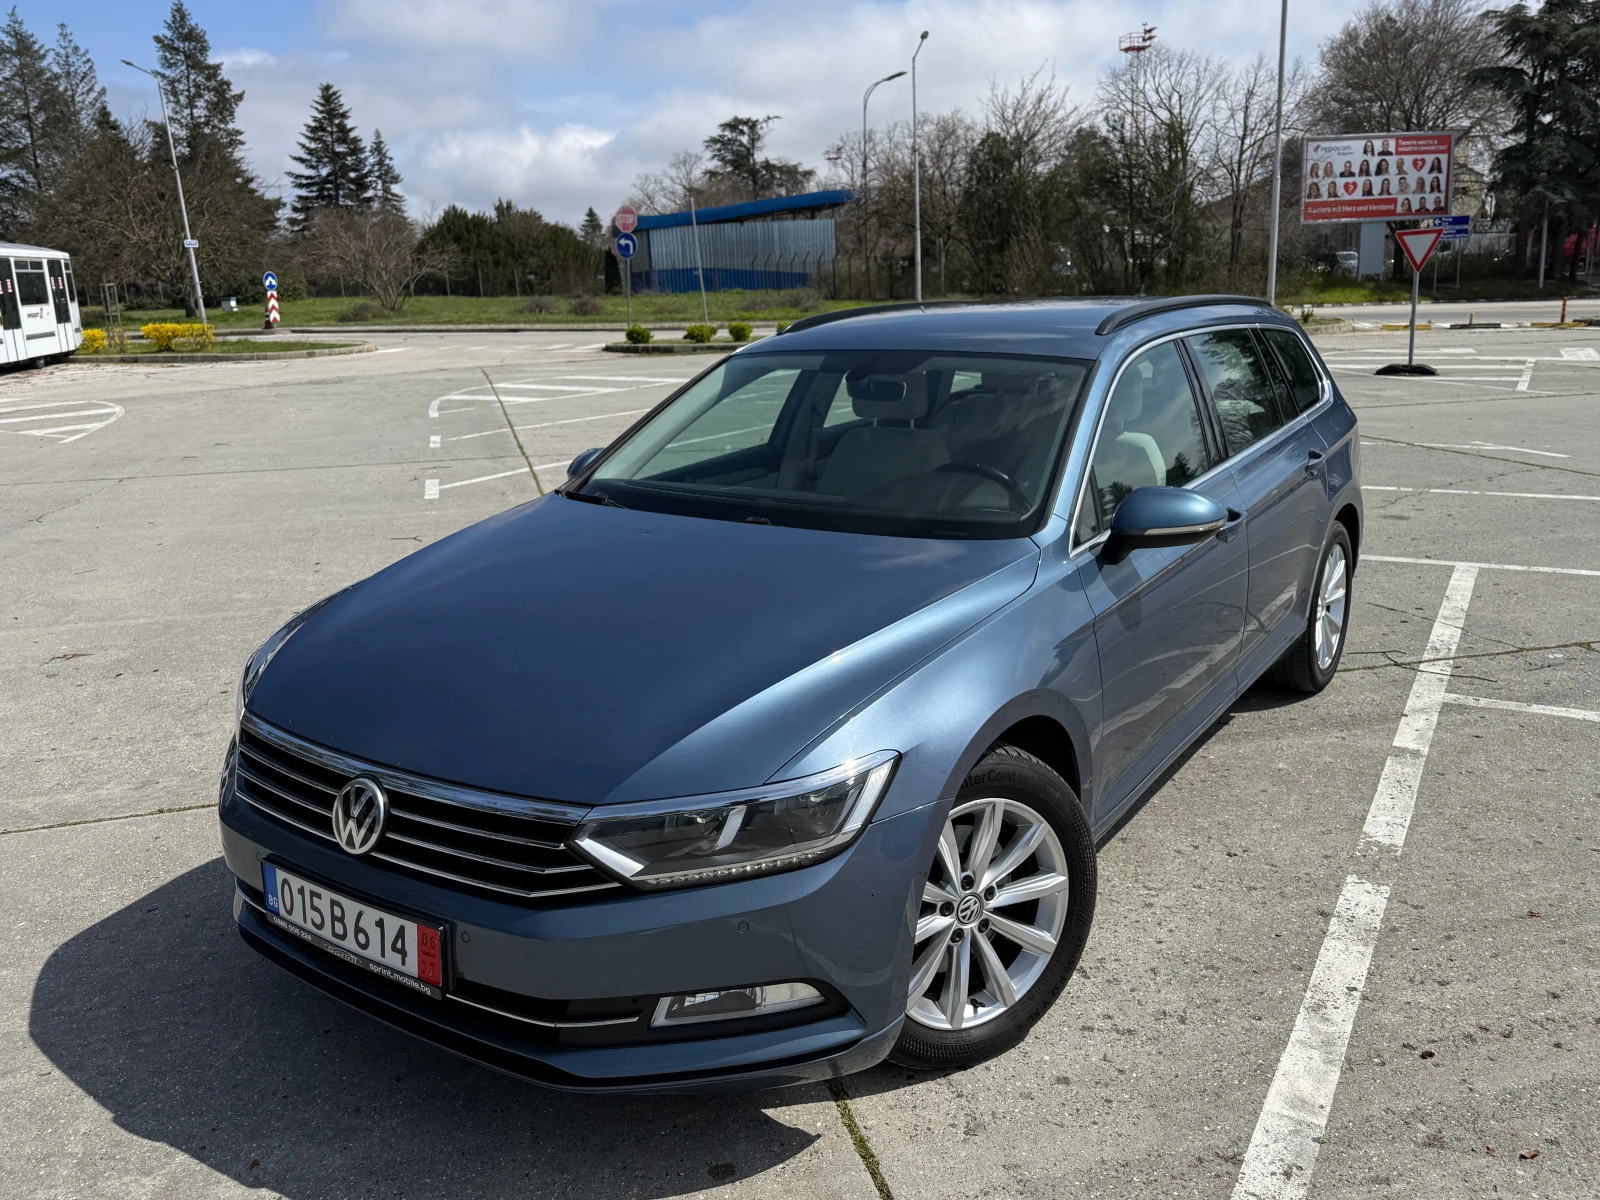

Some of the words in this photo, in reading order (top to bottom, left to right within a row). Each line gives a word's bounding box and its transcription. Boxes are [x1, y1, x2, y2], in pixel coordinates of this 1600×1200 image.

[616, 214, 635, 224] STOP
[268, 893, 279, 908] BG
[280, 877, 408, 967] 015B614
[421, 932, 436, 949] 06
[1064, 935, 1084, 974] 215/55
[369, 963, 432, 996] sprint.mobile.bg
[1026, 1009, 1041, 1022] XL
